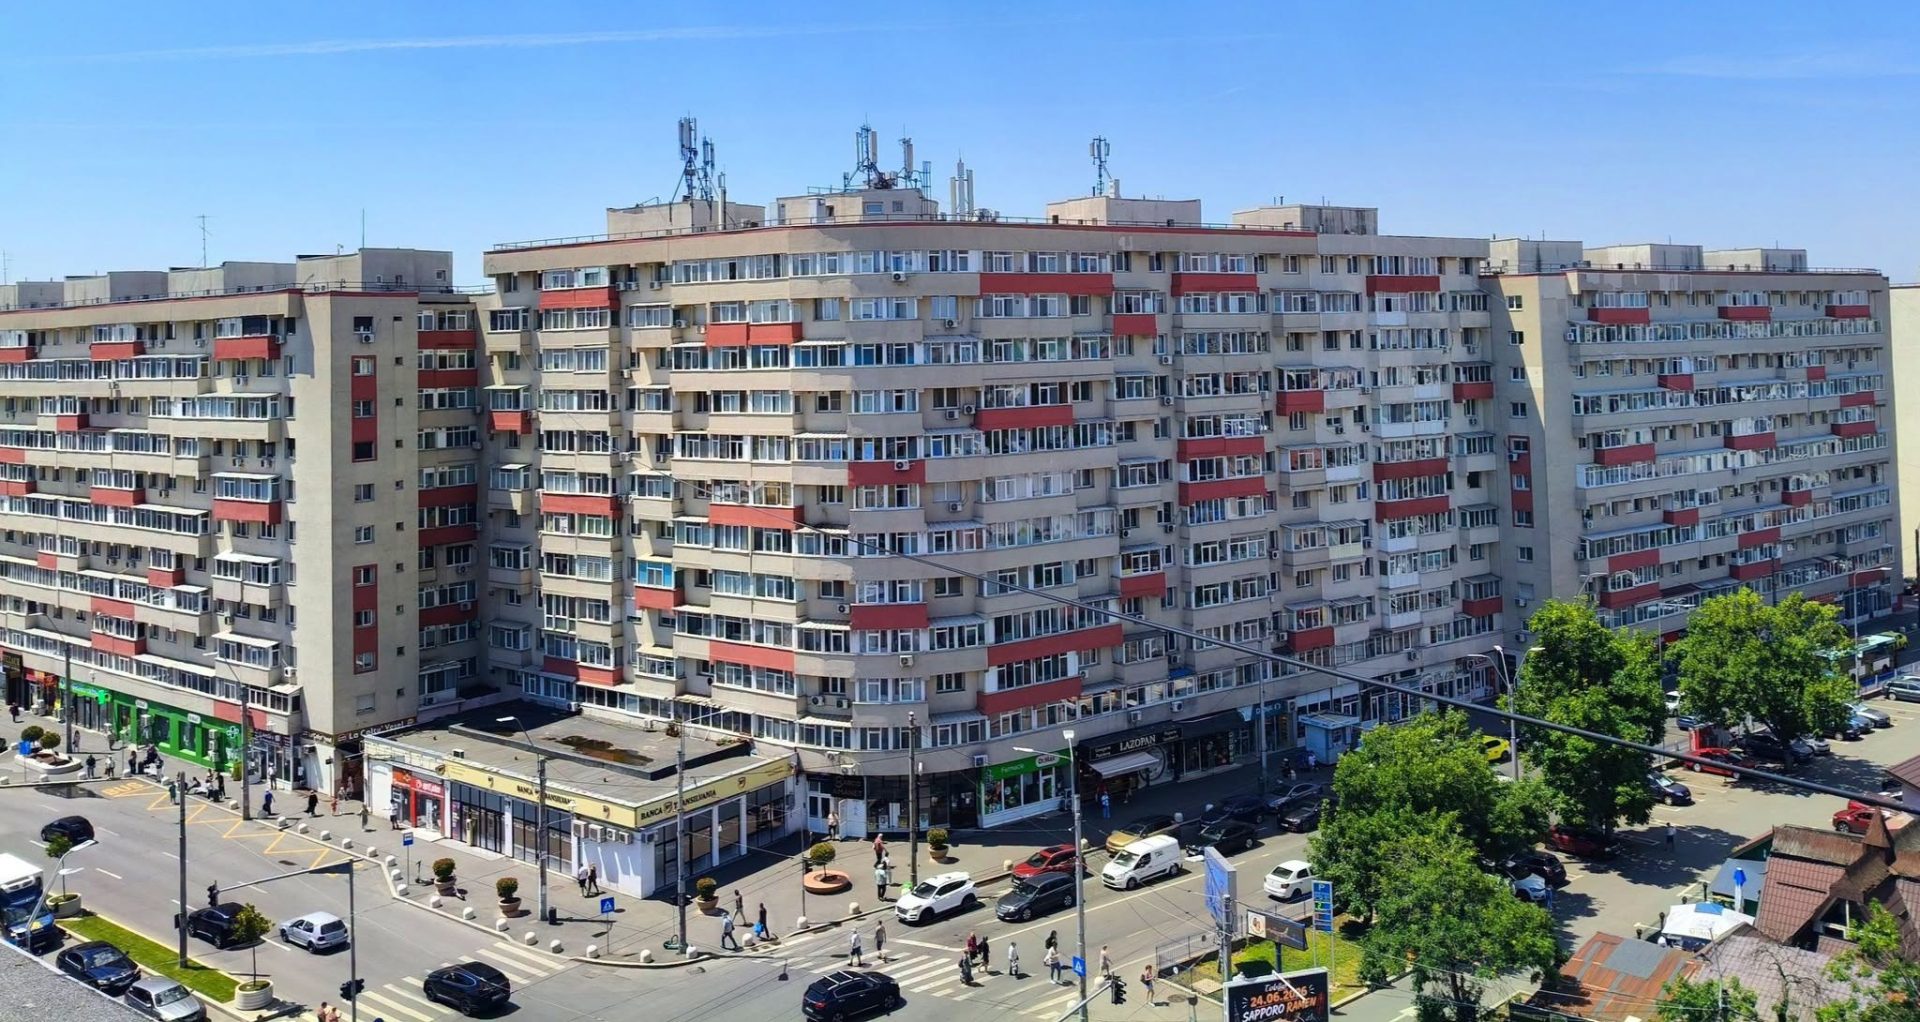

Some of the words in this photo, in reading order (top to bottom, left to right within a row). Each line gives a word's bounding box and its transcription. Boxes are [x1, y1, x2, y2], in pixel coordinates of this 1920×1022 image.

[1119, 734, 1156, 751] LAZOPAN
[101, 782, 144, 796] BUS
[516, 785, 533, 795] BANCA
[641, 807, 663, 820] BANCA
[673, 789, 716, 809] TANSILVANIA
[1242, 1004, 1285, 1022] SAPPORO
[1286, 996, 1317, 1013] RAMEN
